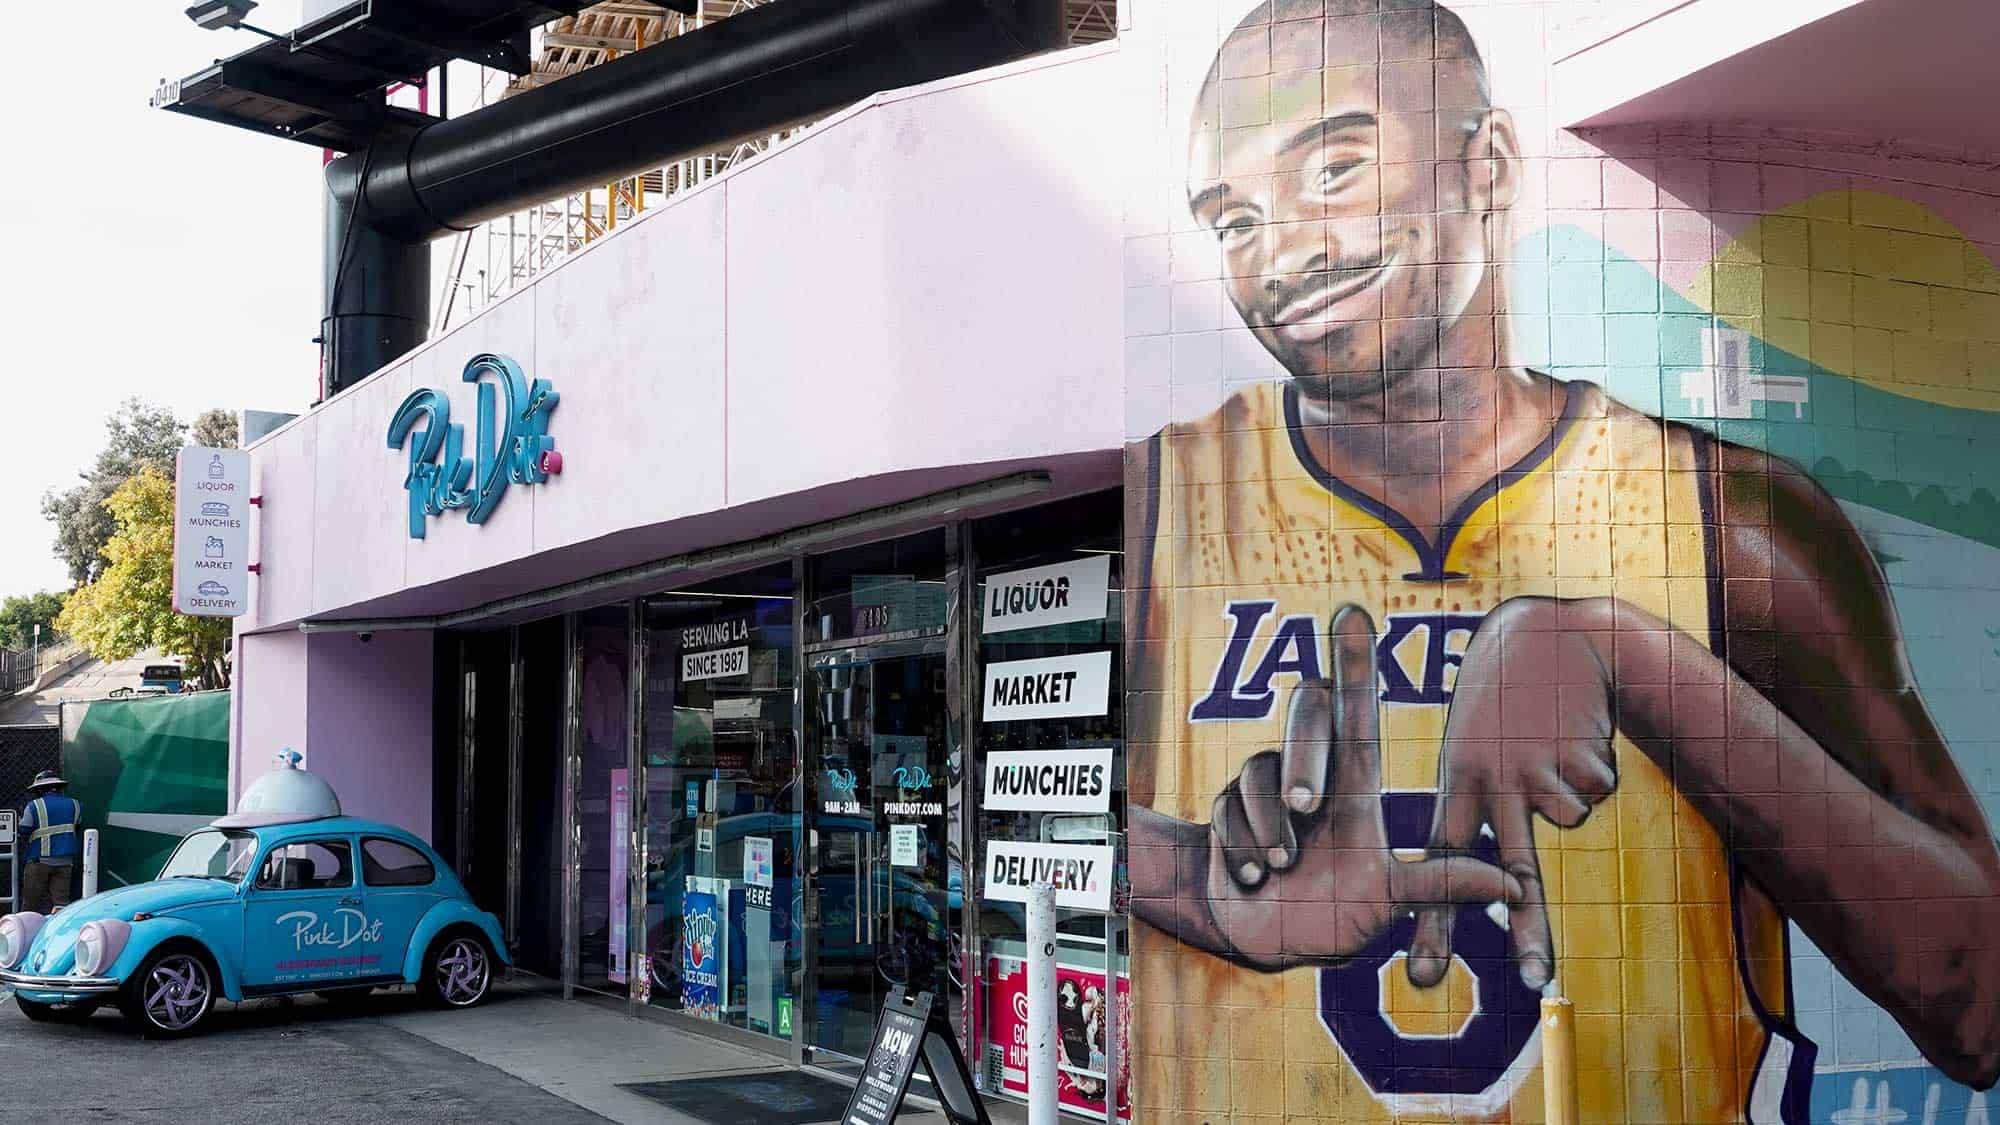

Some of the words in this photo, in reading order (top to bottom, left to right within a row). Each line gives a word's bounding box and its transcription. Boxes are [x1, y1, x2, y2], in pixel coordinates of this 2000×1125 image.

[197, 481, 235, 492] LIQUOR
[188, 518, 241, 528] MUNCHIES
[194, 561, 233, 570] MARKET
[190, 598, 237, 608] DELIVERY
[991, 575, 1070, 618] LIQUOR
[682, 622, 730, 649] SERVING
[732, 618, 749, 641] LA
[687, 654, 717, 677] SINCE
[720, 650, 744, 673] 1987
[992, 671, 1077, 707] MARKET
[992, 765, 1104, 797] MUNCHIES
[883, 802, 943, 815] PINKDOT.COM
[745, 887, 772, 907] HERE
[275, 910, 339, 951] Pink
[696, 971, 718, 988] CREAM
[881, 1026, 914, 1057] NOW
